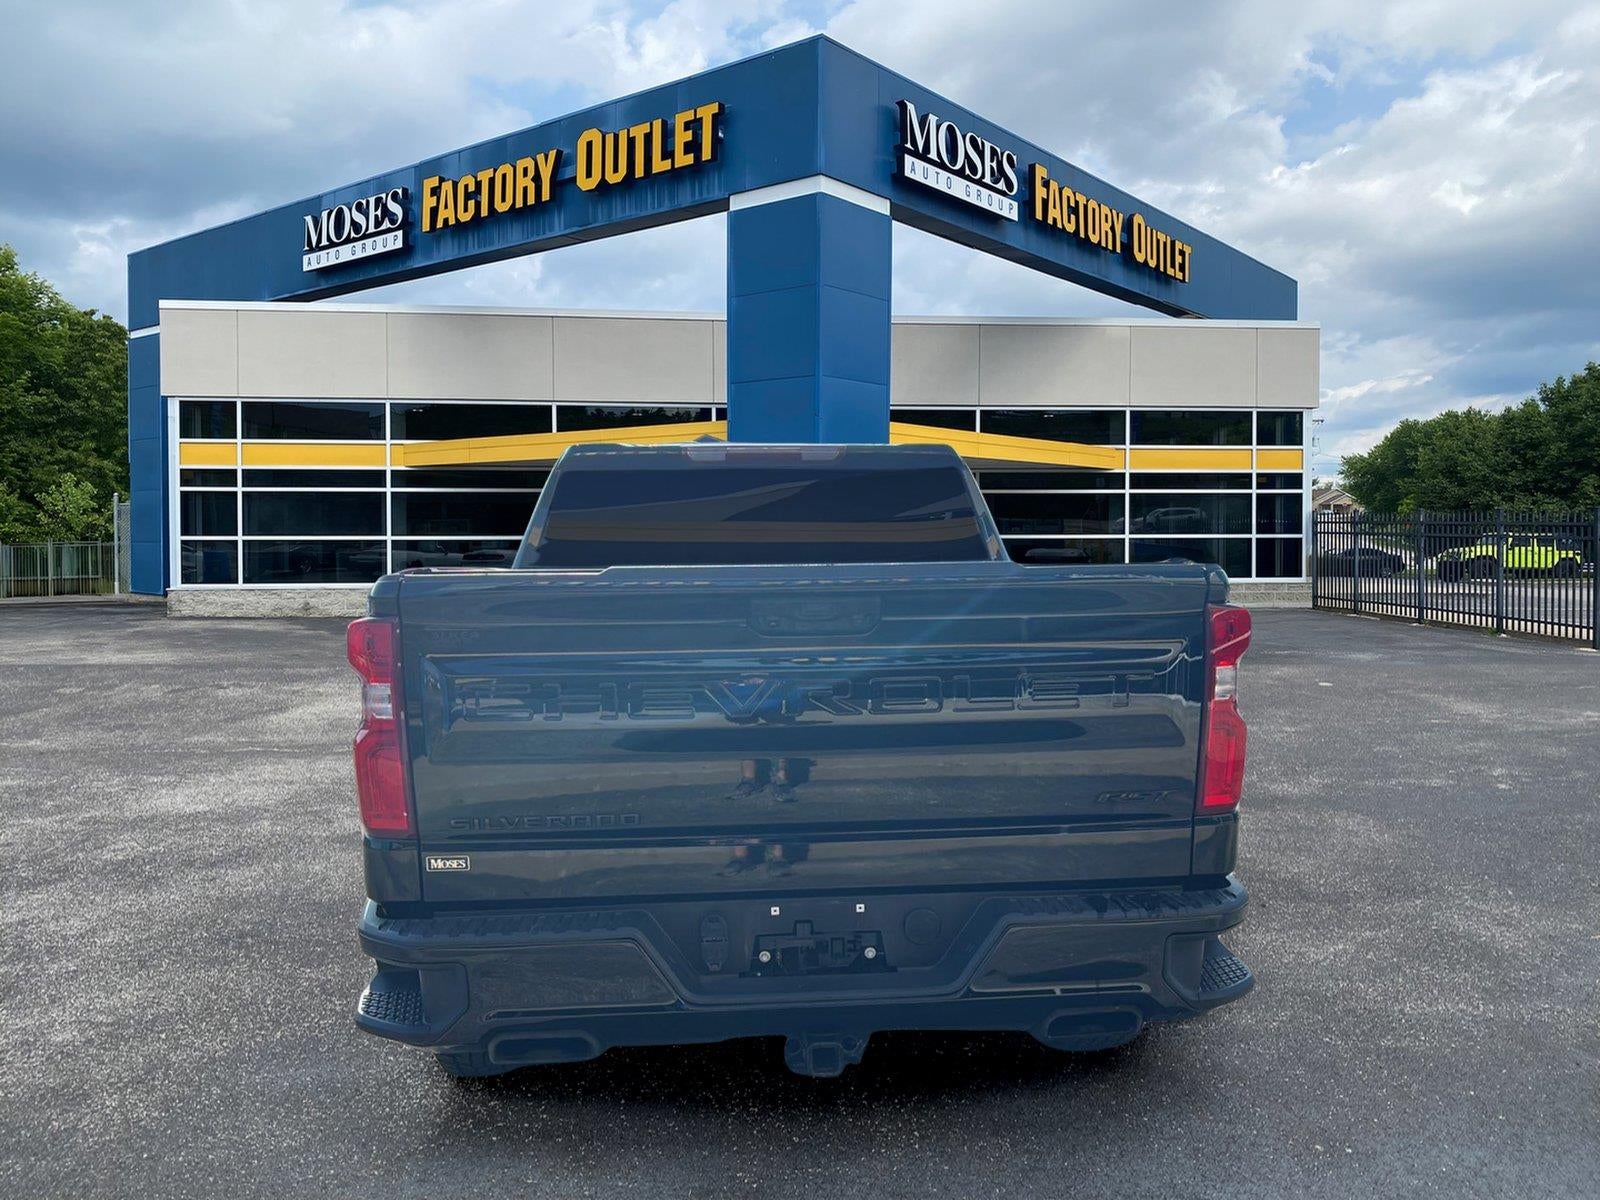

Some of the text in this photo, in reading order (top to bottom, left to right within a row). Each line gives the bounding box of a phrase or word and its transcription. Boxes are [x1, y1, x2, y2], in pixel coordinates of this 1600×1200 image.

[903, 99, 1018, 196] MOSES
[910, 161, 1014, 214] AUTO GROUP
[303, 187, 403, 251] MOSES
[307, 234, 399, 267] AUTO GROUP
[449, 813, 642, 831] SILVERADO
